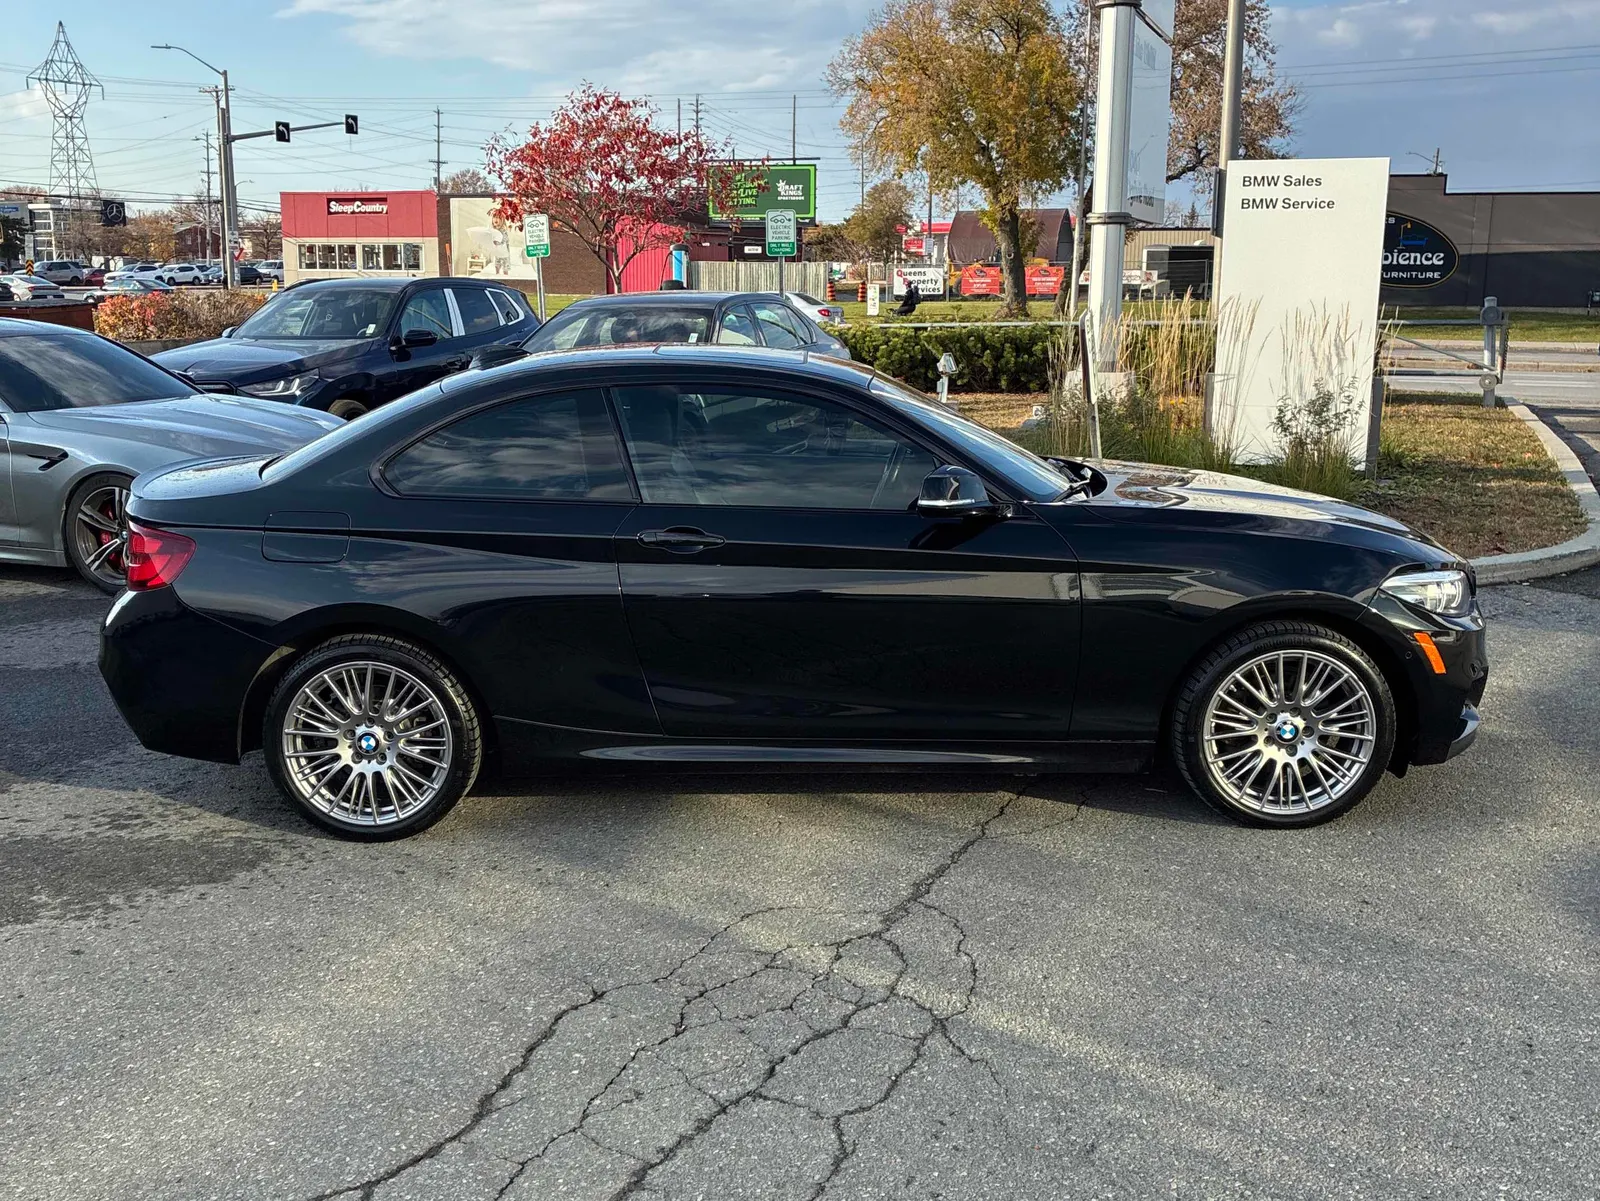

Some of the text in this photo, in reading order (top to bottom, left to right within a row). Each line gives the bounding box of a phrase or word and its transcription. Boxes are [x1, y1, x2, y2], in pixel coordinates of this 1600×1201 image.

[1242, 174, 1322, 187] BMW Sales
[738, 188, 758, 197] LIVE
[777, 184, 804, 192] DRAFT
[1241, 197, 1335, 210] BMW Service
[1382, 249, 1444, 265] bience
[896, 269, 926, 278] Queens
[903, 278, 938, 286] Poperty
